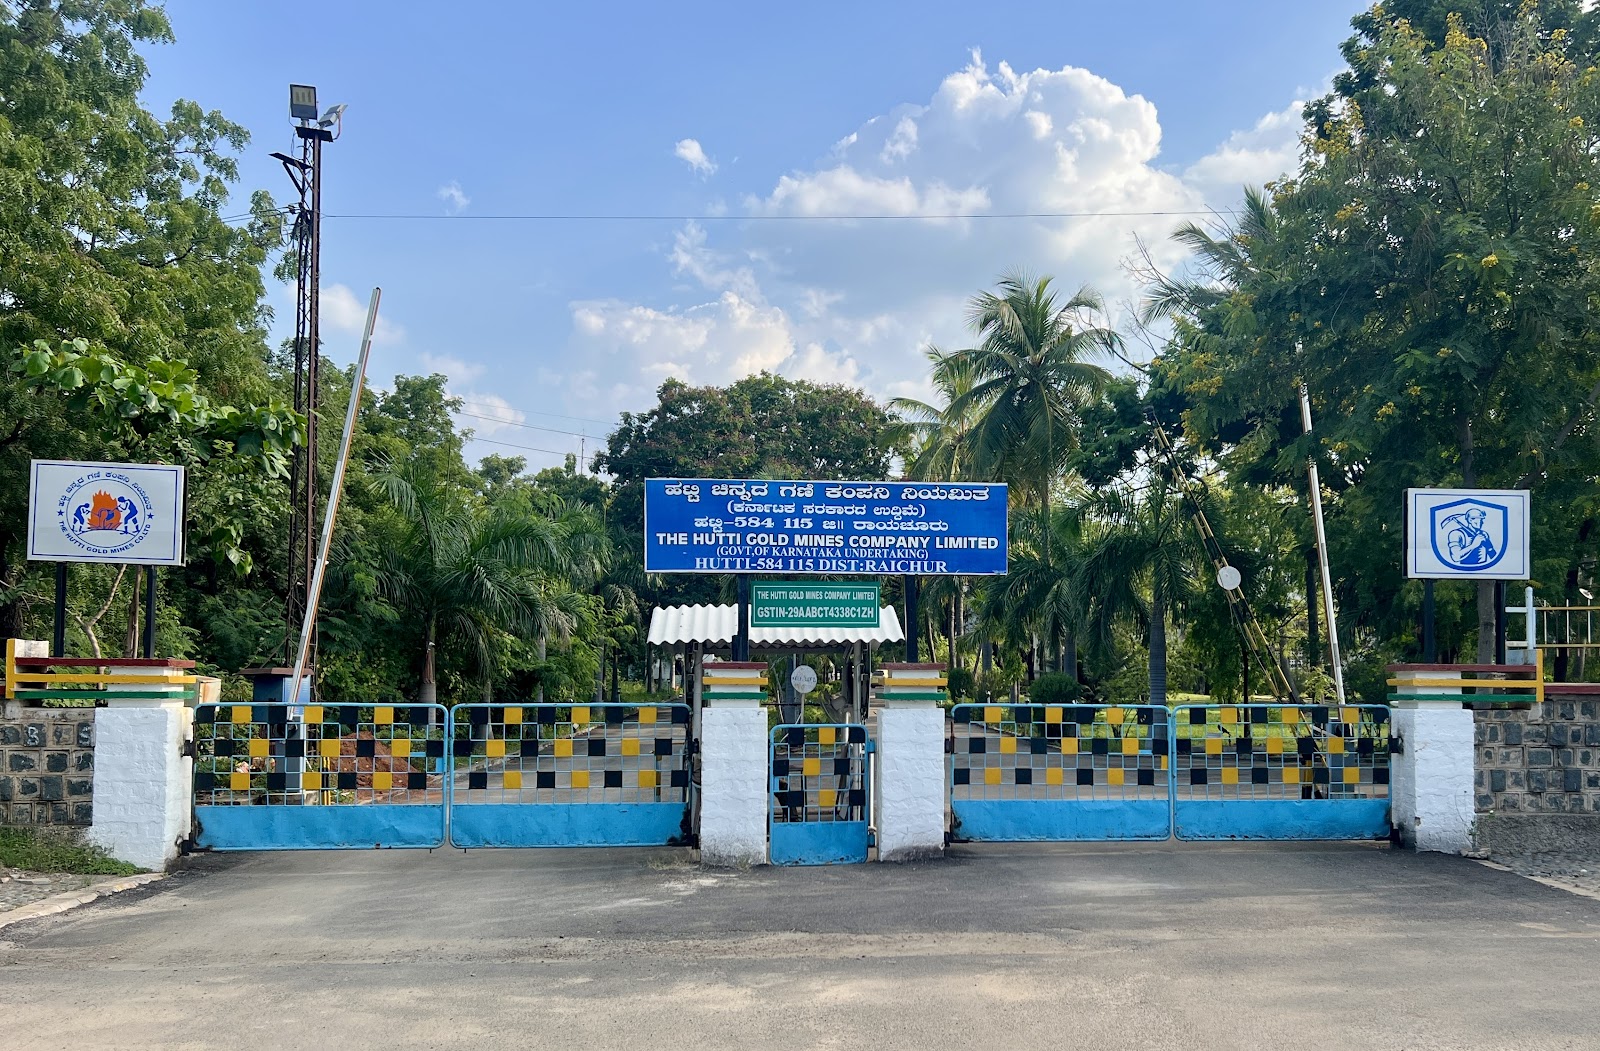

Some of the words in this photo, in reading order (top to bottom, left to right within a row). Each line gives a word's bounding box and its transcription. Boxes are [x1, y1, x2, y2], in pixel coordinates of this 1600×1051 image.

[664, 481, 700, 503] ಹಟ್ಟಿ
[711, 482, 769, 501] ಚಿನ್ನದ
[779, 483, 814, 498] ಗಣಿ
[825, 484, 890, 500] ಕಂಪನಿ
[901, 485, 990, 501] ನಿಯಮಿತ
[727, 500, 796, 514] (ಕರ್ನಾಟಕ
[803, 502, 866, 516] ಸರಕಾರದ
[783, 517, 813, 529] 115
[853, 519, 949, 532] ರಾಯಚೂರು
[58, 520, 67, 533] THE
[65, 533, 85, 549] HUTTI
[86, 546, 108, 554] GOLD
[110, 543, 135, 554] MINES
[656, 532, 688, 545] THE
[693, 532, 741, 545] HUTTI
[746, 533, 789, 546] GOLD
[794, 534, 844, 547] MINES
[849, 535, 931, 549] COMPANY
[936, 536, 999, 549] LIMITED
[772, 547, 842, 558] KARNATAKA
[844, 548, 929, 560] UNDERTAKING)
[695, 557, 783, 570] HUTTI-584
[788, 558, 814, 571] 115
[818, 559, 948, 573] DIST:RAICHUR
[757, 590, 769, 600] THE
[770, 591, 788, 600] HUTTI
[788, 591, 804, 600] GOLD
[805, 591, 823, 600] MINES
[824, 591, 851, 600] COMPANY
[852, 591, 875, 601] LIMITED
[757, 606, 874, 618] GSTIN-29AABCT4338C1ZH
